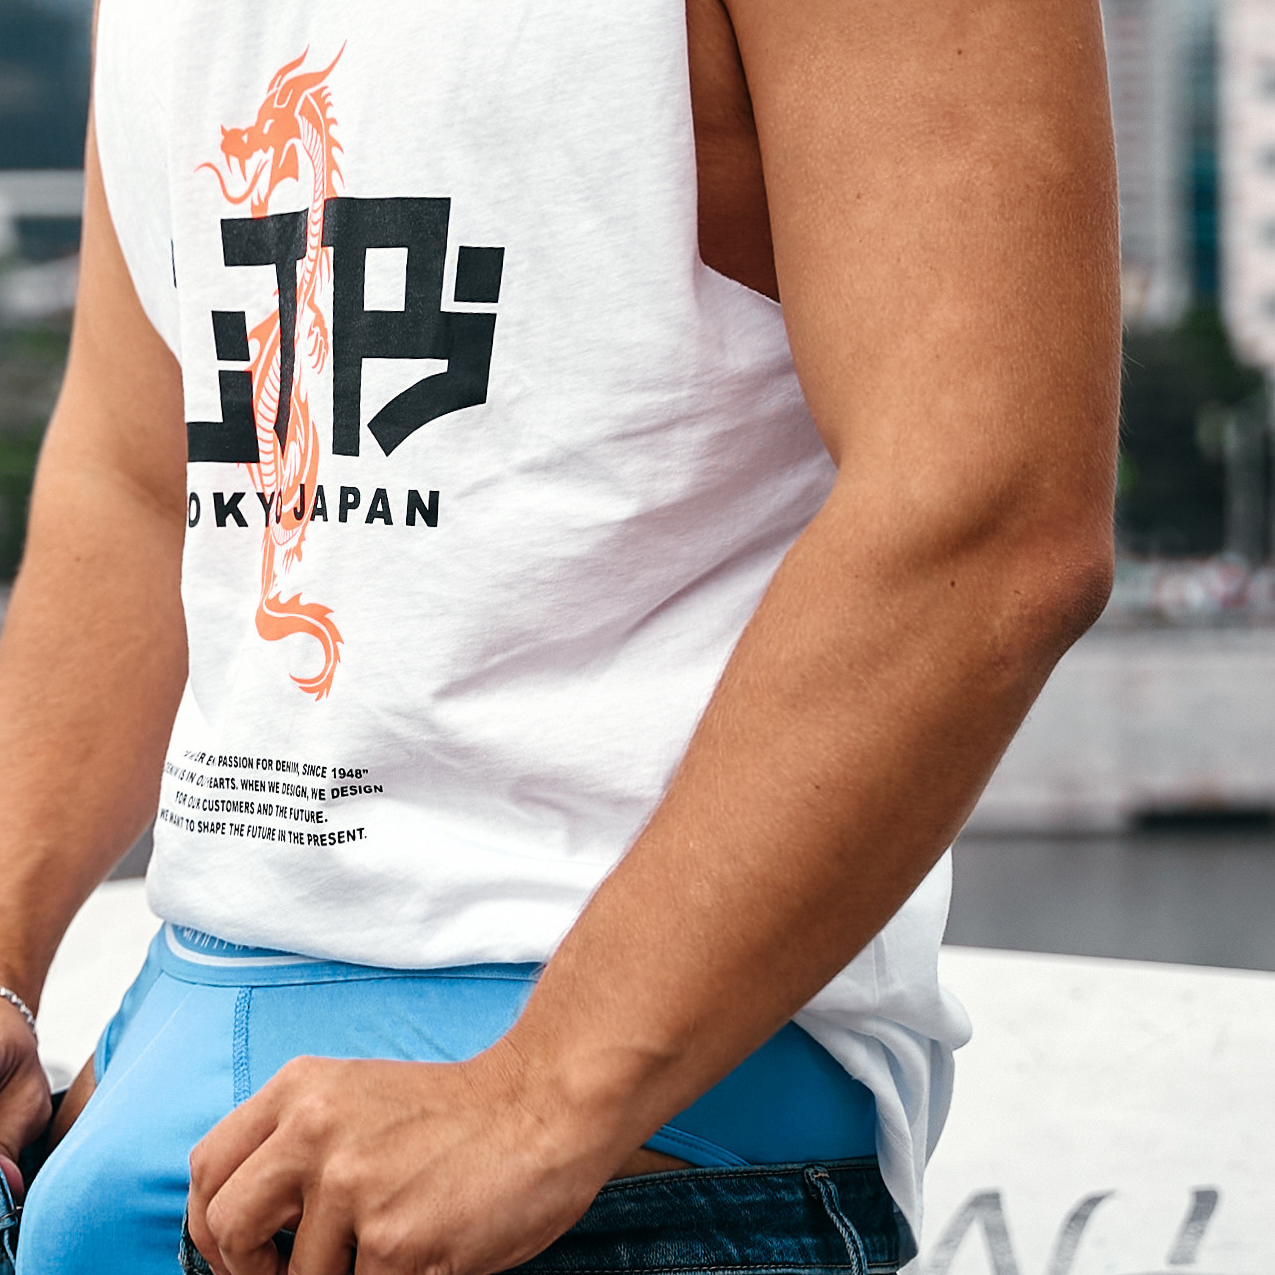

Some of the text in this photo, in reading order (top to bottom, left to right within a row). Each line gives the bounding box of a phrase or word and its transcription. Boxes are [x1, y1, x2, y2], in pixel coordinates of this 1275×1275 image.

[188, 483, 440, 528] OKYO JAPAN
[217, 755, 254, 769] PASSION
[256, 758, 273, 771] FOR
[275, 759, 300, 777] DENIM,
[302, 763, 327, 778] SINCE
[207, 776, 239, 790] EARTS.
[240, 778, 266, 793] WHEN
[267, 781, 280, 794] WE
[281, 782, 309, 801] DESIGN,
[311, 787, 326, 801] WE
[331, 784, 384, 800] DESIGN
[202, 798, 255, 815] CUSTOMERS
[257, 803, 274, 816] AND
[275, 804, 288, 819] THE
[289, 807, 328, 824] FUTURE.
[185, 818, 195, 832] TO
[197, 820, 226, 835] SHAPE
[229, 822, 246, 837] THE
[246, 824, 276, 842] FUTURE
[278, 829, 286, 842] IN
[288, 830, 305, 845] THE
[307, 827, 367, 847] PRESENT.
